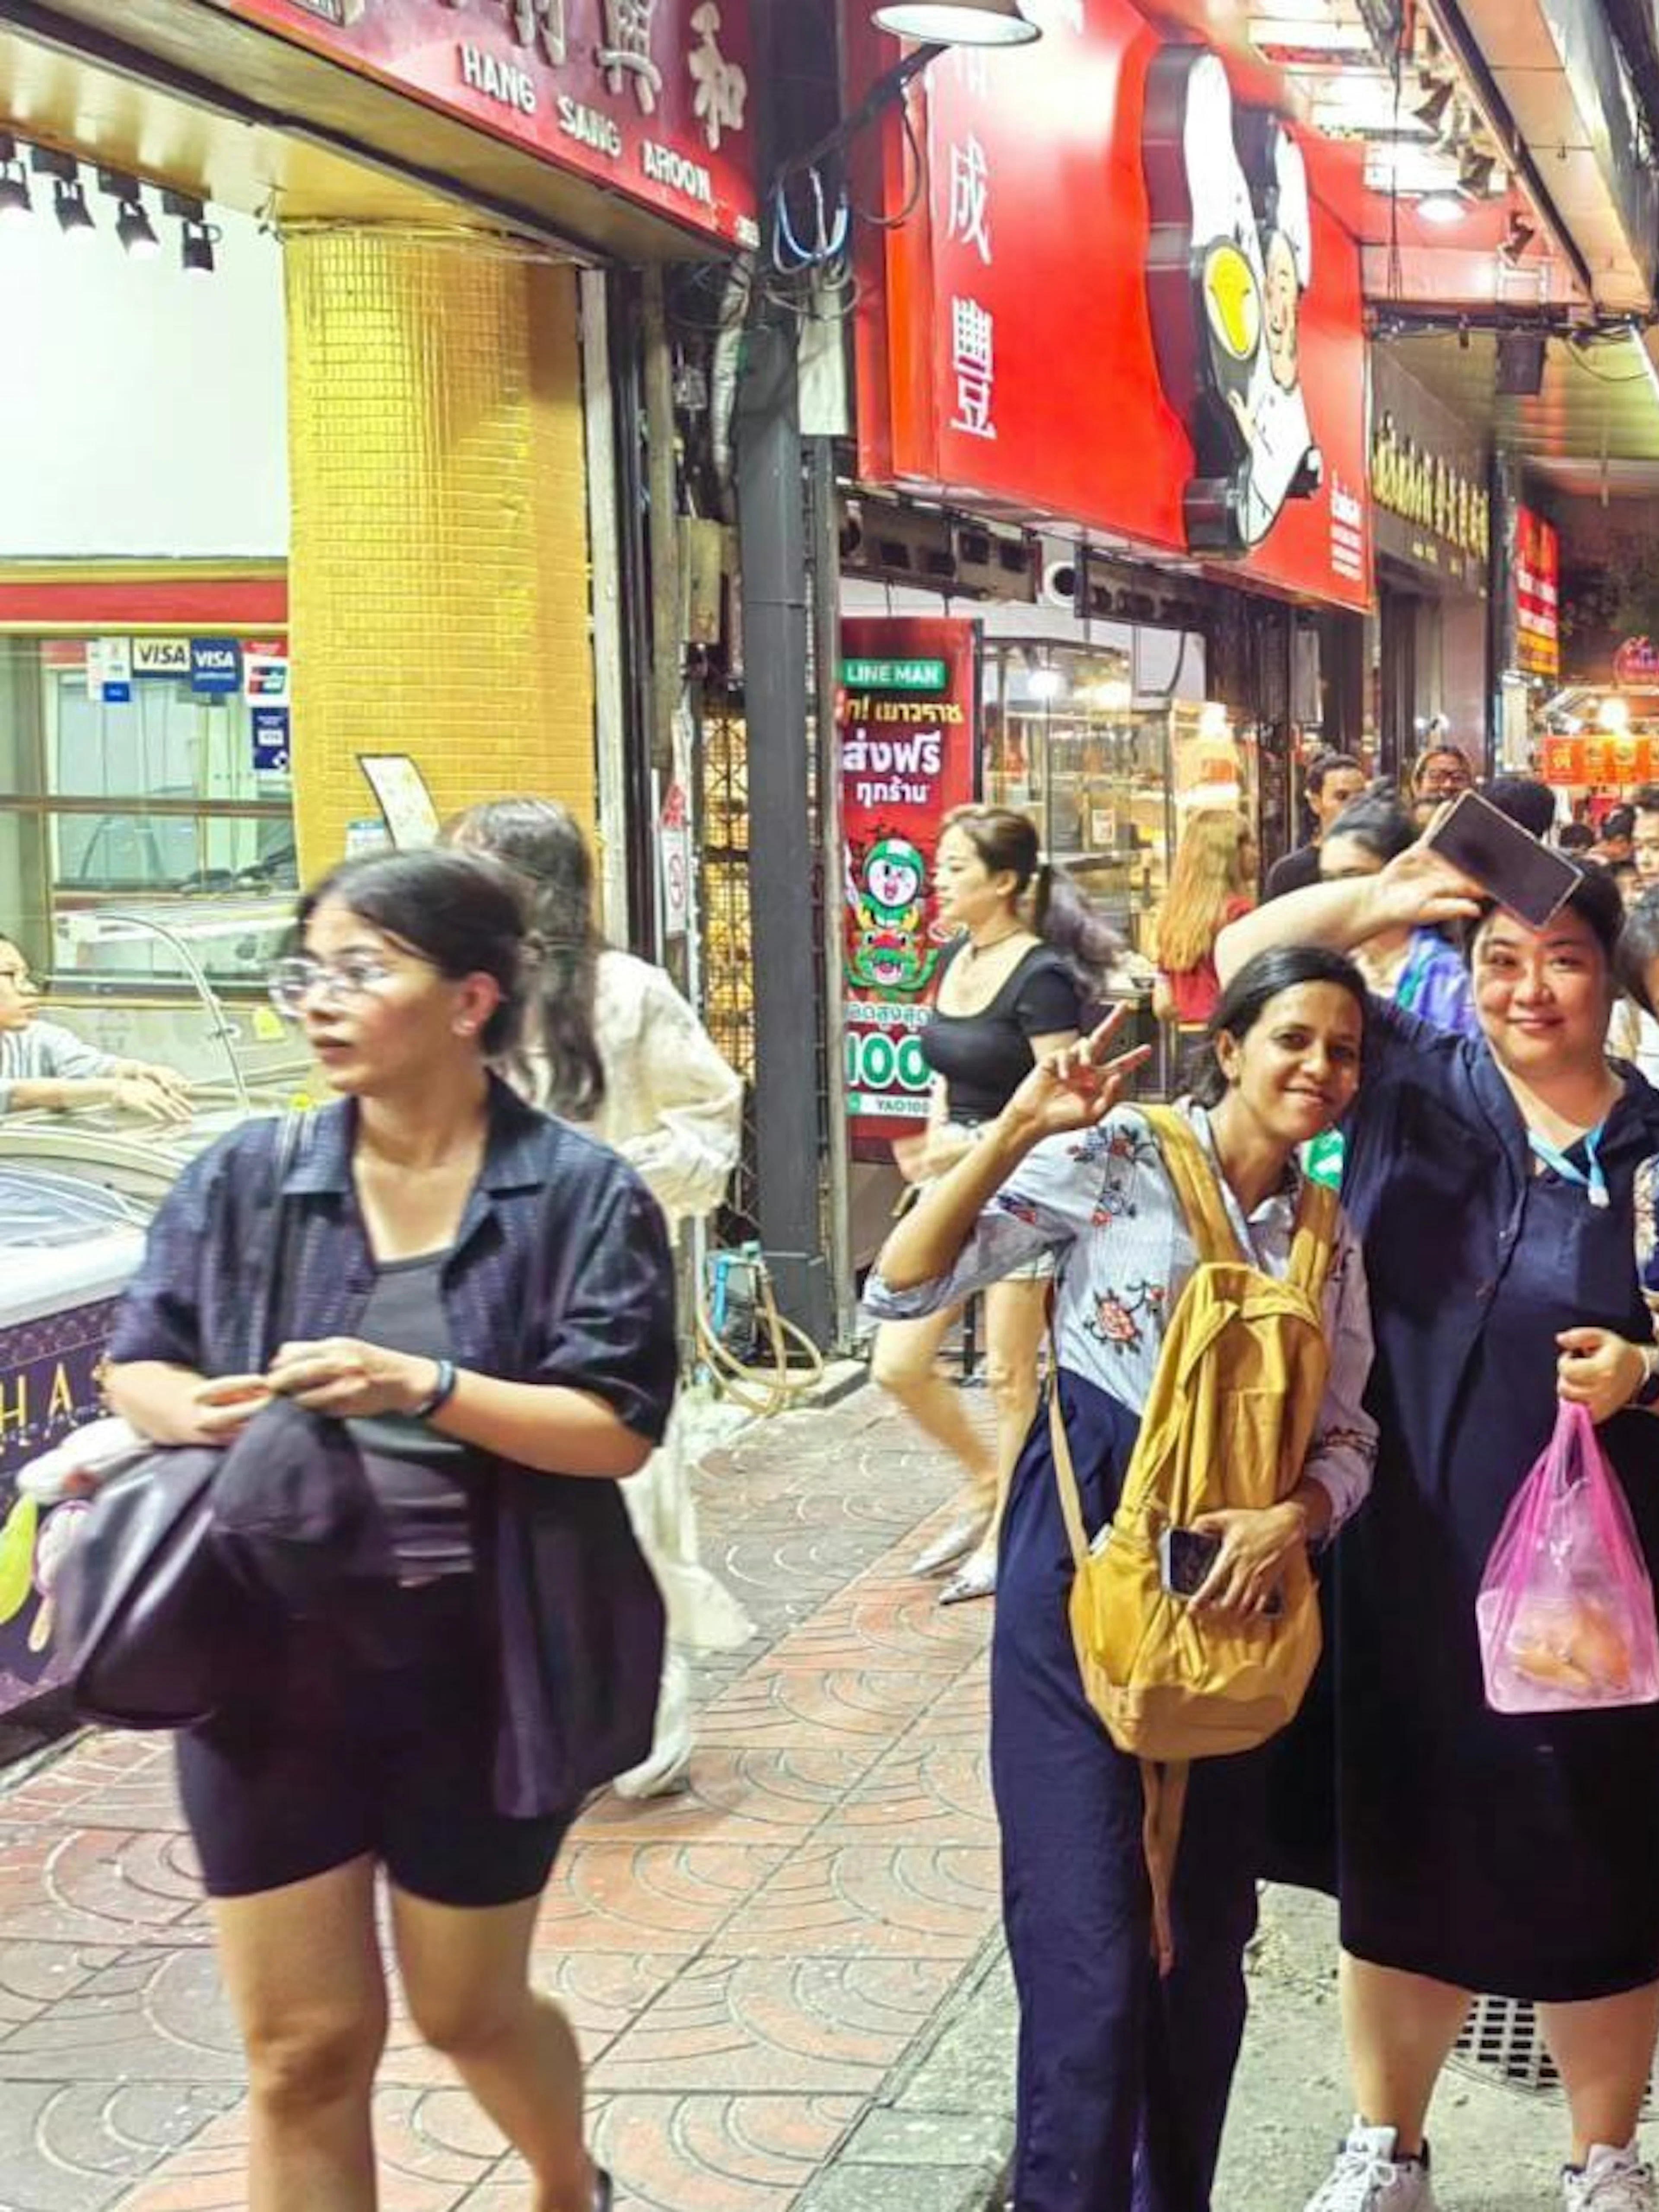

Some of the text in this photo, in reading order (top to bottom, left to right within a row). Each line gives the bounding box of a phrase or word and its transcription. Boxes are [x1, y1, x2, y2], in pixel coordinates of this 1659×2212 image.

[460, 42, 712, 204] HANG SANG AROON
[140, 645, 186, 664] VISA
[194, 651, 234, 668] VISA
[847, 664, 938, 683] LINE MAN
[843, 728, 941, 774] ส่งฟรี
[857, 775, 927, 808] ทุกร้าน
